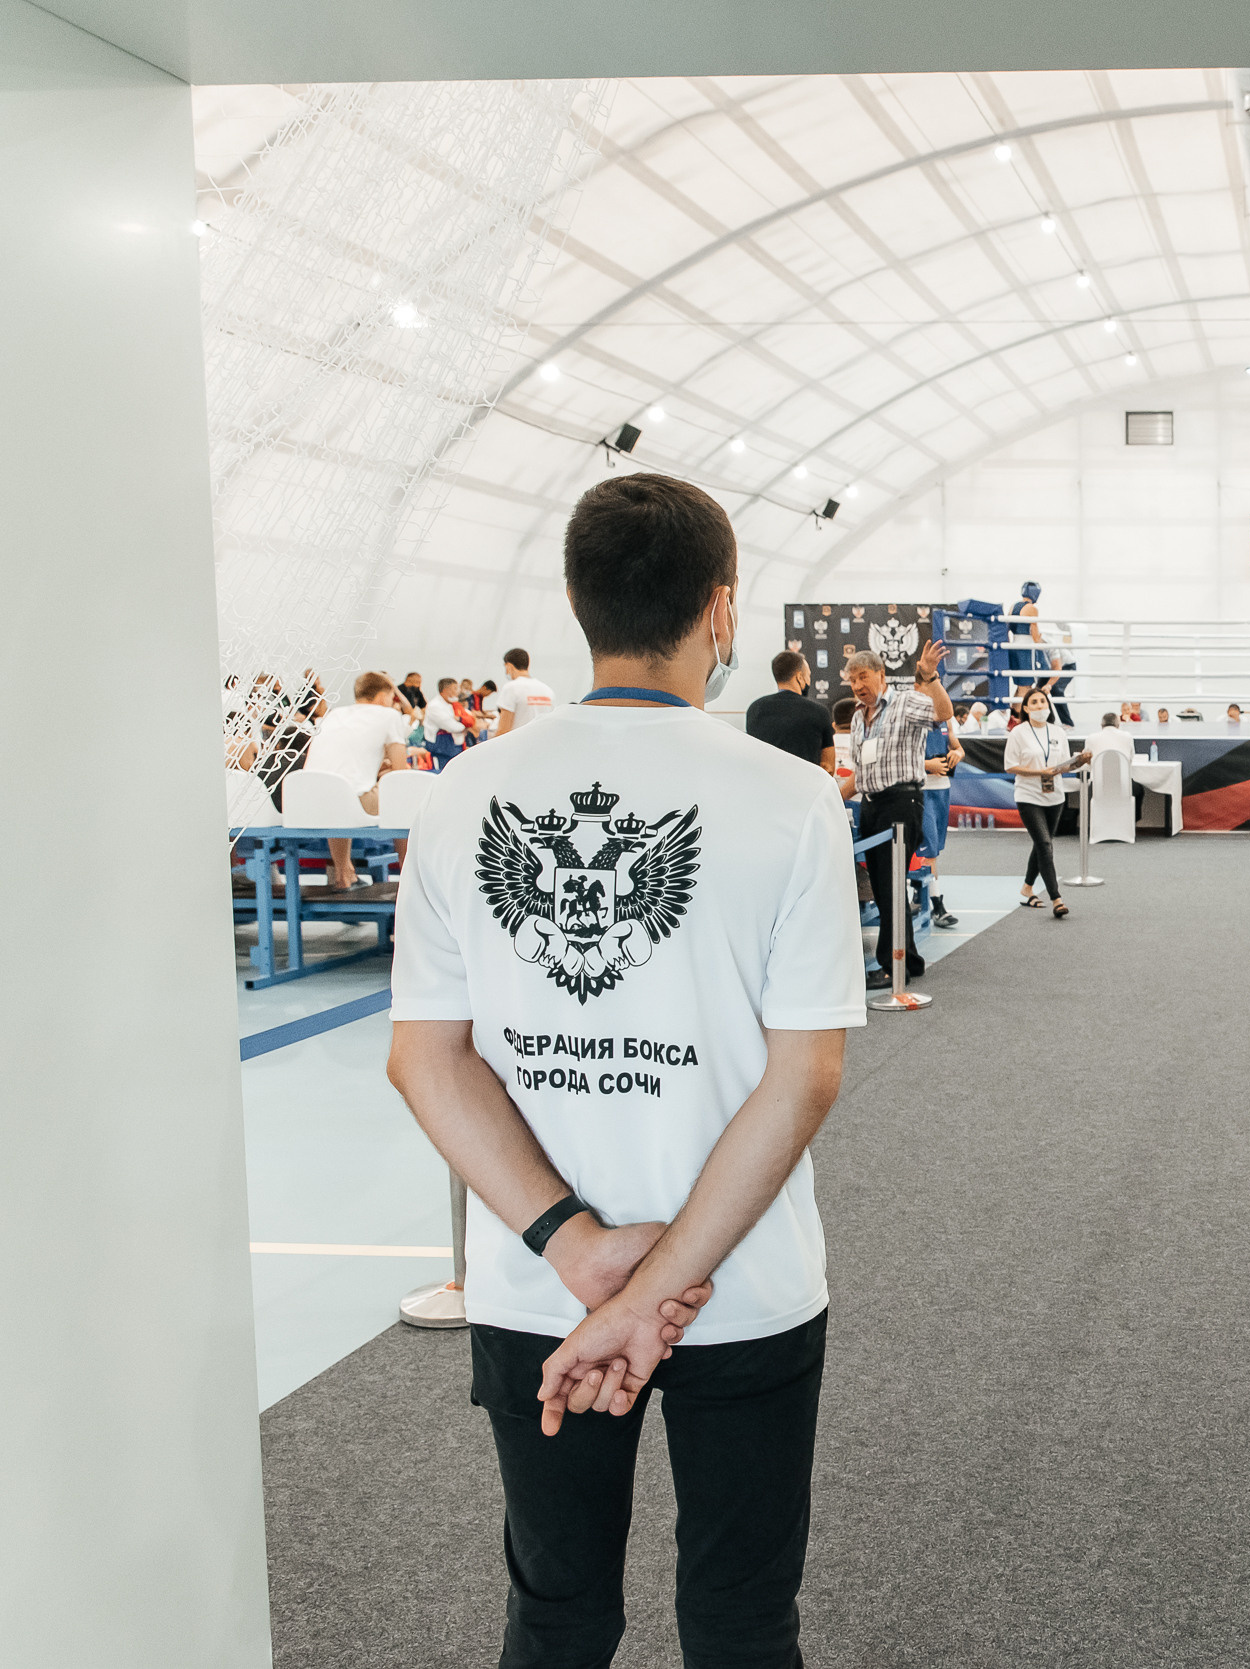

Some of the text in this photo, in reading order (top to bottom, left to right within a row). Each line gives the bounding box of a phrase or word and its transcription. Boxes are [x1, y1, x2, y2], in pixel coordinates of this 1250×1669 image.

[503, 1026, 699, 1066] ФЕДЕРАЦИЯ БОКСА
[516, 1065, 661, 1098] ГОРОДА СОЧИ
